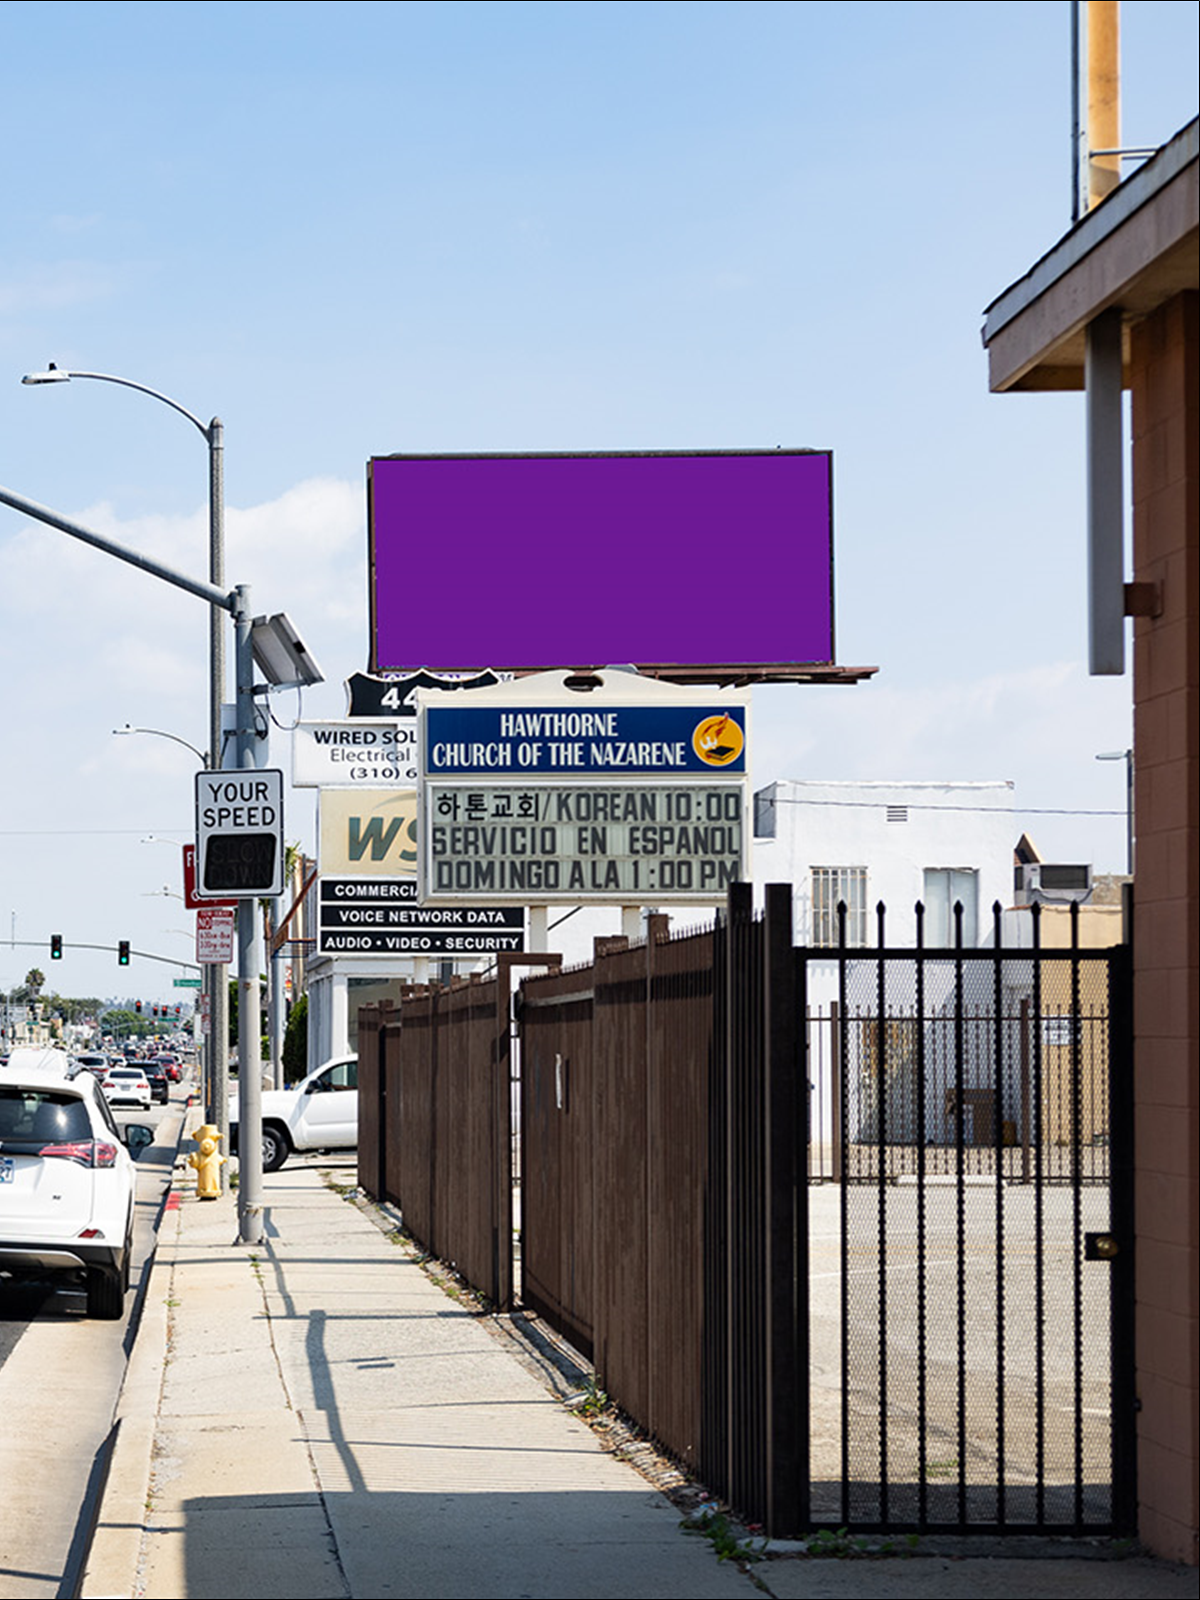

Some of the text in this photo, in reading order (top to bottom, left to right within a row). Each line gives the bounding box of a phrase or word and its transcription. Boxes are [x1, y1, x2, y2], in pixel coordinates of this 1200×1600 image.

[501, 713, 618, 737] HAWTHORNE
[314, 731, 377, 744] WIRED
[330, 748, 410, 762] Electrical
[432, 742, 687, 767] CHURCH OF THE NAZARENE
[350, 767, 400, 779] (310)
[208, 782, 268, 803] YOUR
[203, 806, 275, 828] SPEED
[665, 792, 740, 821] 10:00
[432, 826, 739, 855] SERVICIO EN ESPANOL
[437, 860, 559, 889] DOMINGO
[632, 860, 692, 889] 1:00
[700, 860, 739, 889] PM
[339, 911, 505, 923] VOICE NETWORK DATA
[325, 937, 519, 949] AUDIO VIDEO SECURITY
